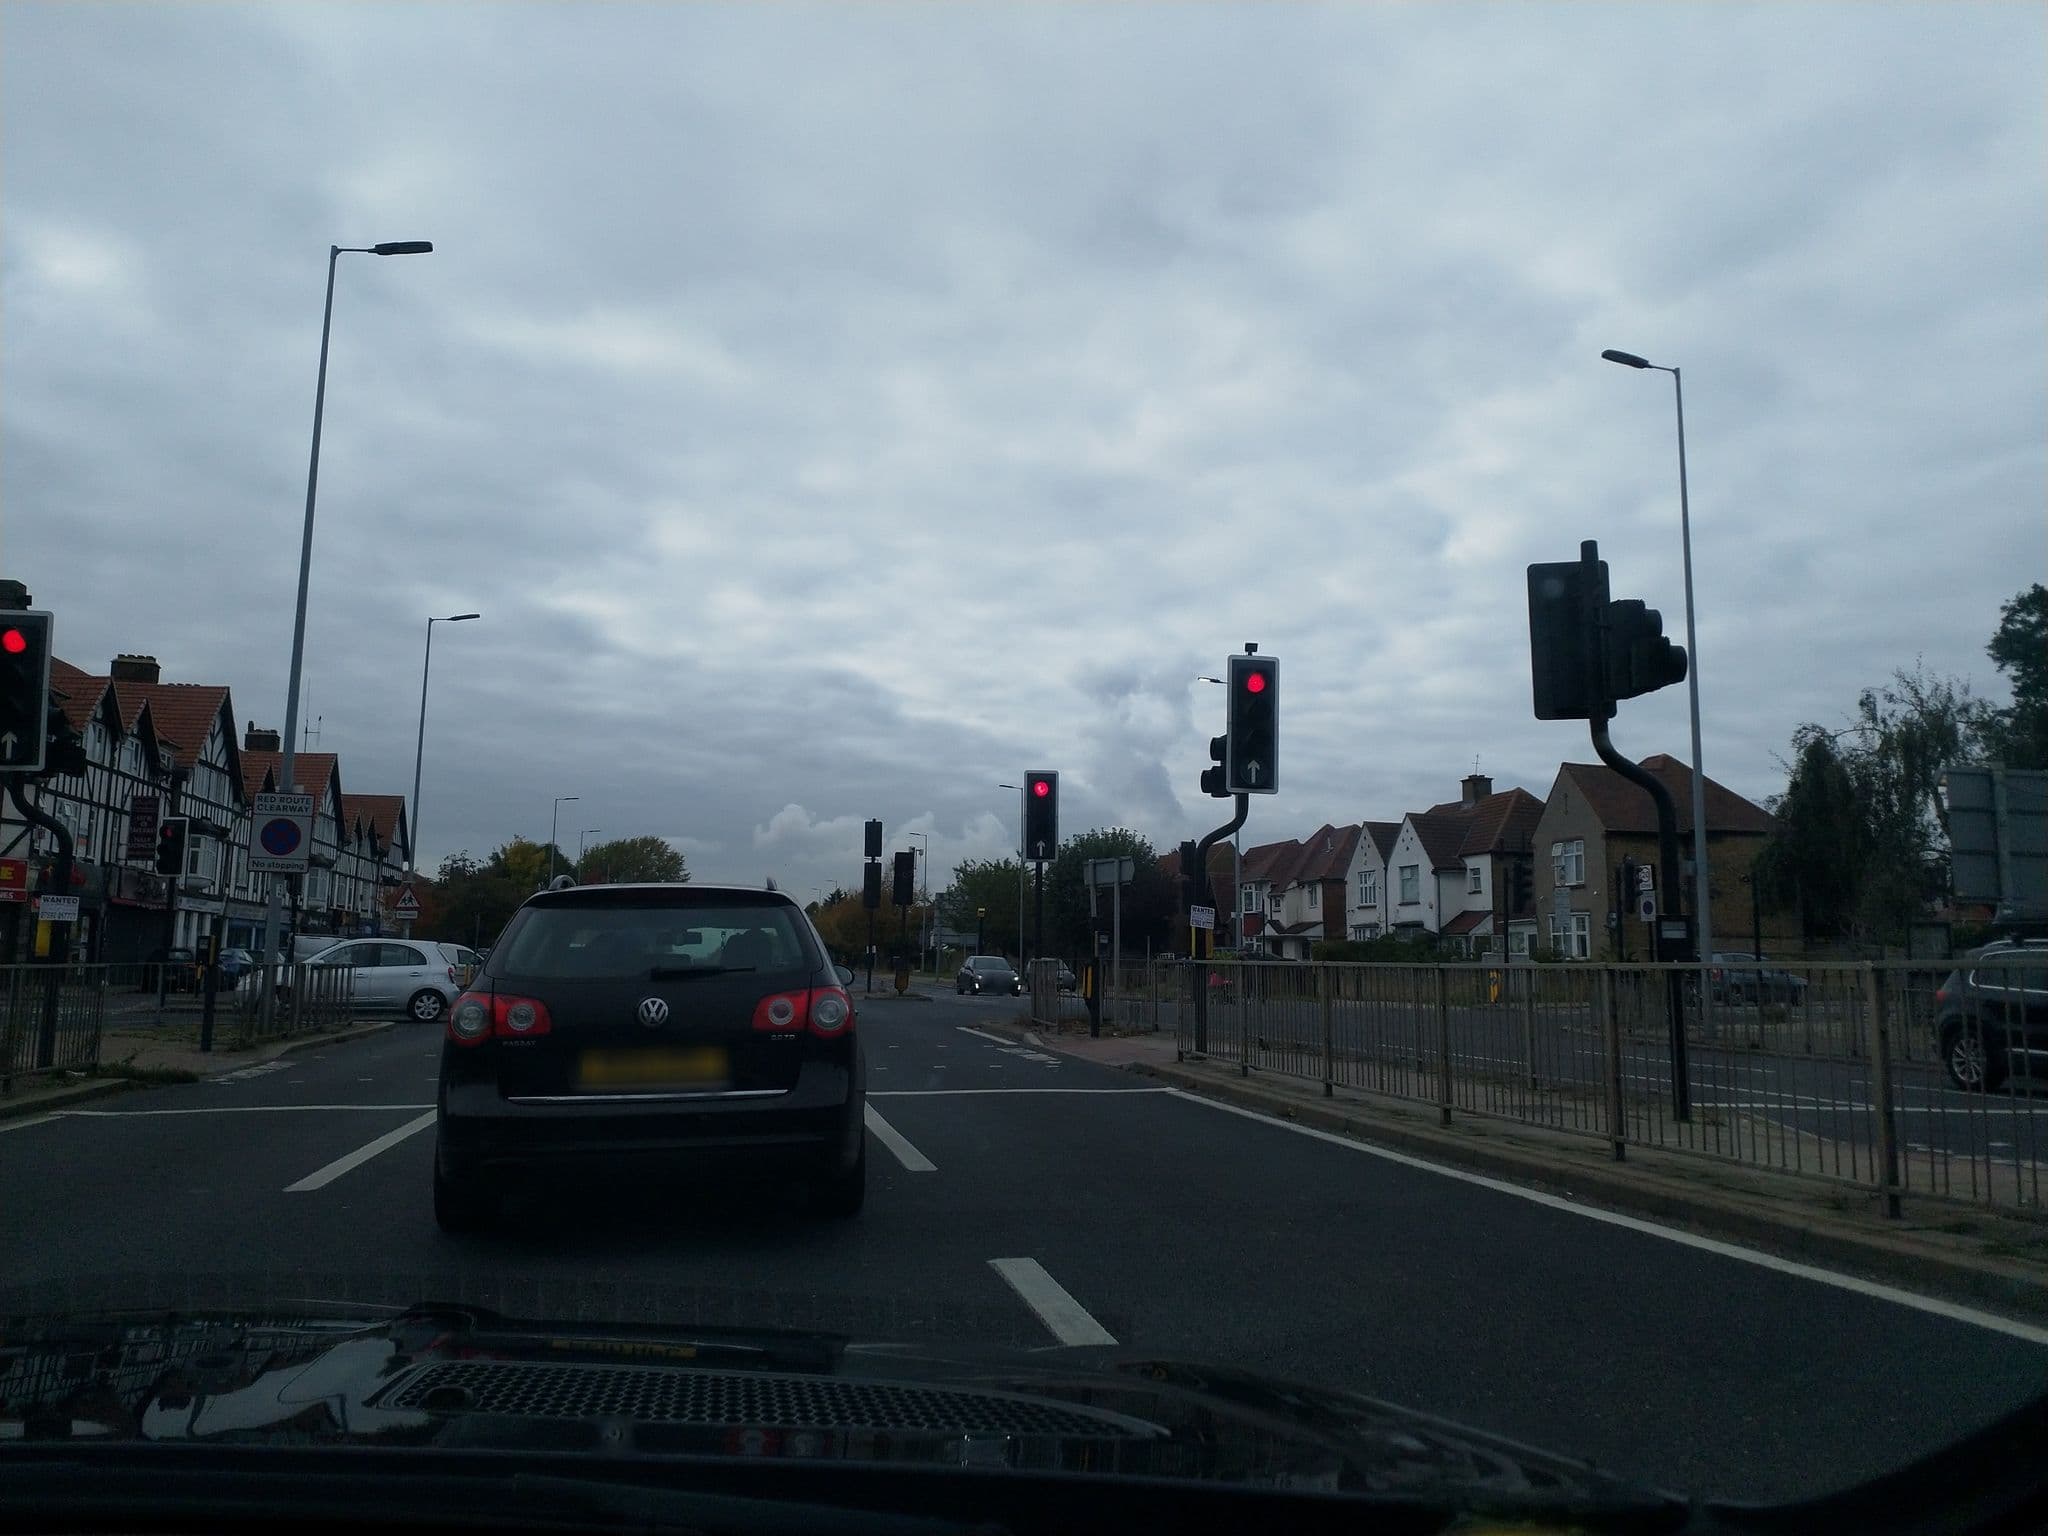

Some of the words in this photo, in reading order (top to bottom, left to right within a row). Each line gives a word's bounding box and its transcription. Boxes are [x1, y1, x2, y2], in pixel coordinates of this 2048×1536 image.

[257, 795, 277, 803] RED
[279, 796, 311, 805] ROUTE
[257, 803, 310, 813] CLEARWAY
[252, 859, 265, 868] No
[268, 861, 305, 871] stopping
[42, 896, 78, 904] WANTED
[638, 997, 669, 1025] VW
